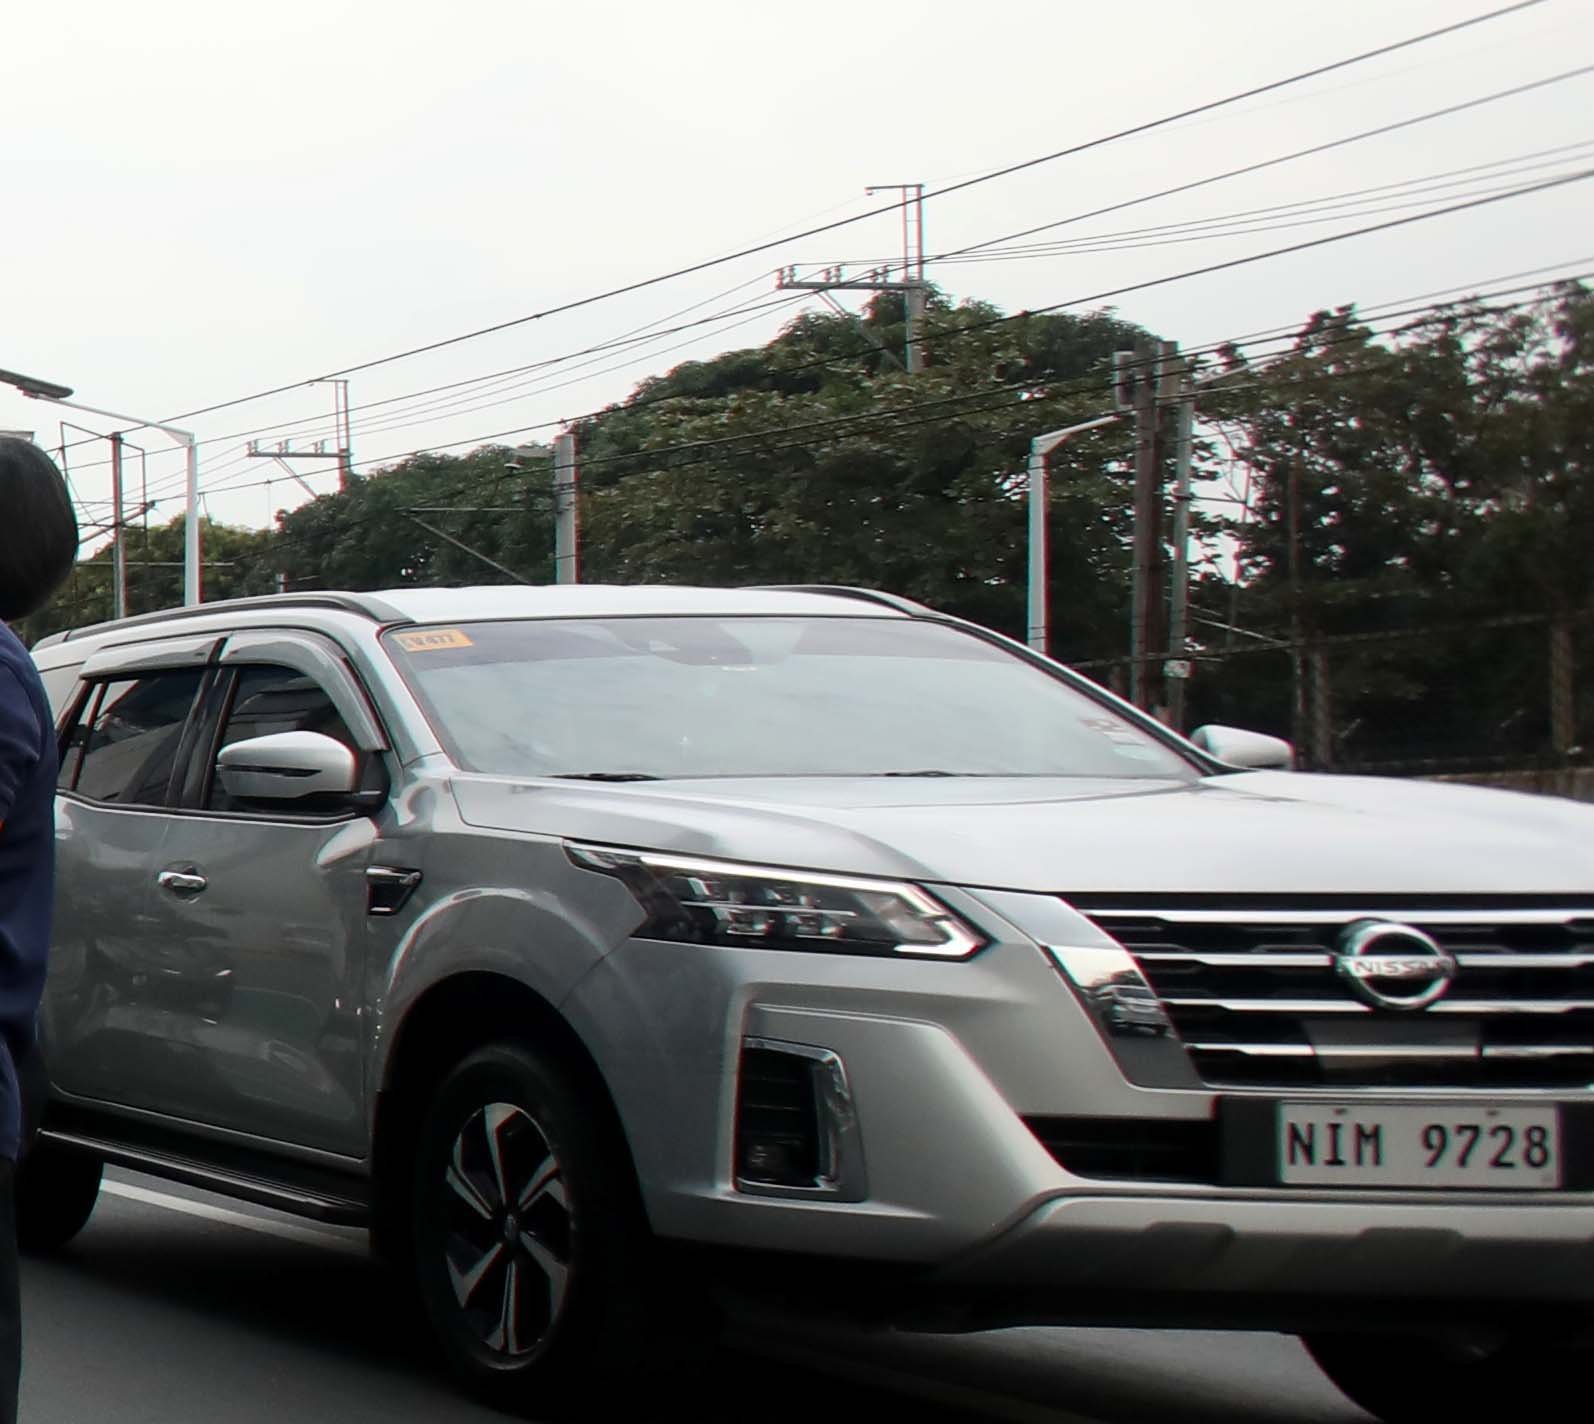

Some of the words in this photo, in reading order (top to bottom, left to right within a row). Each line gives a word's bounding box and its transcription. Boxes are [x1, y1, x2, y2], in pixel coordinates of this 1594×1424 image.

[1355, 957, 1455, 977] NISSAN
[1287, 1122, 1382, 1167] NIM
[1421, 1123, 1551, 1169] 9728
